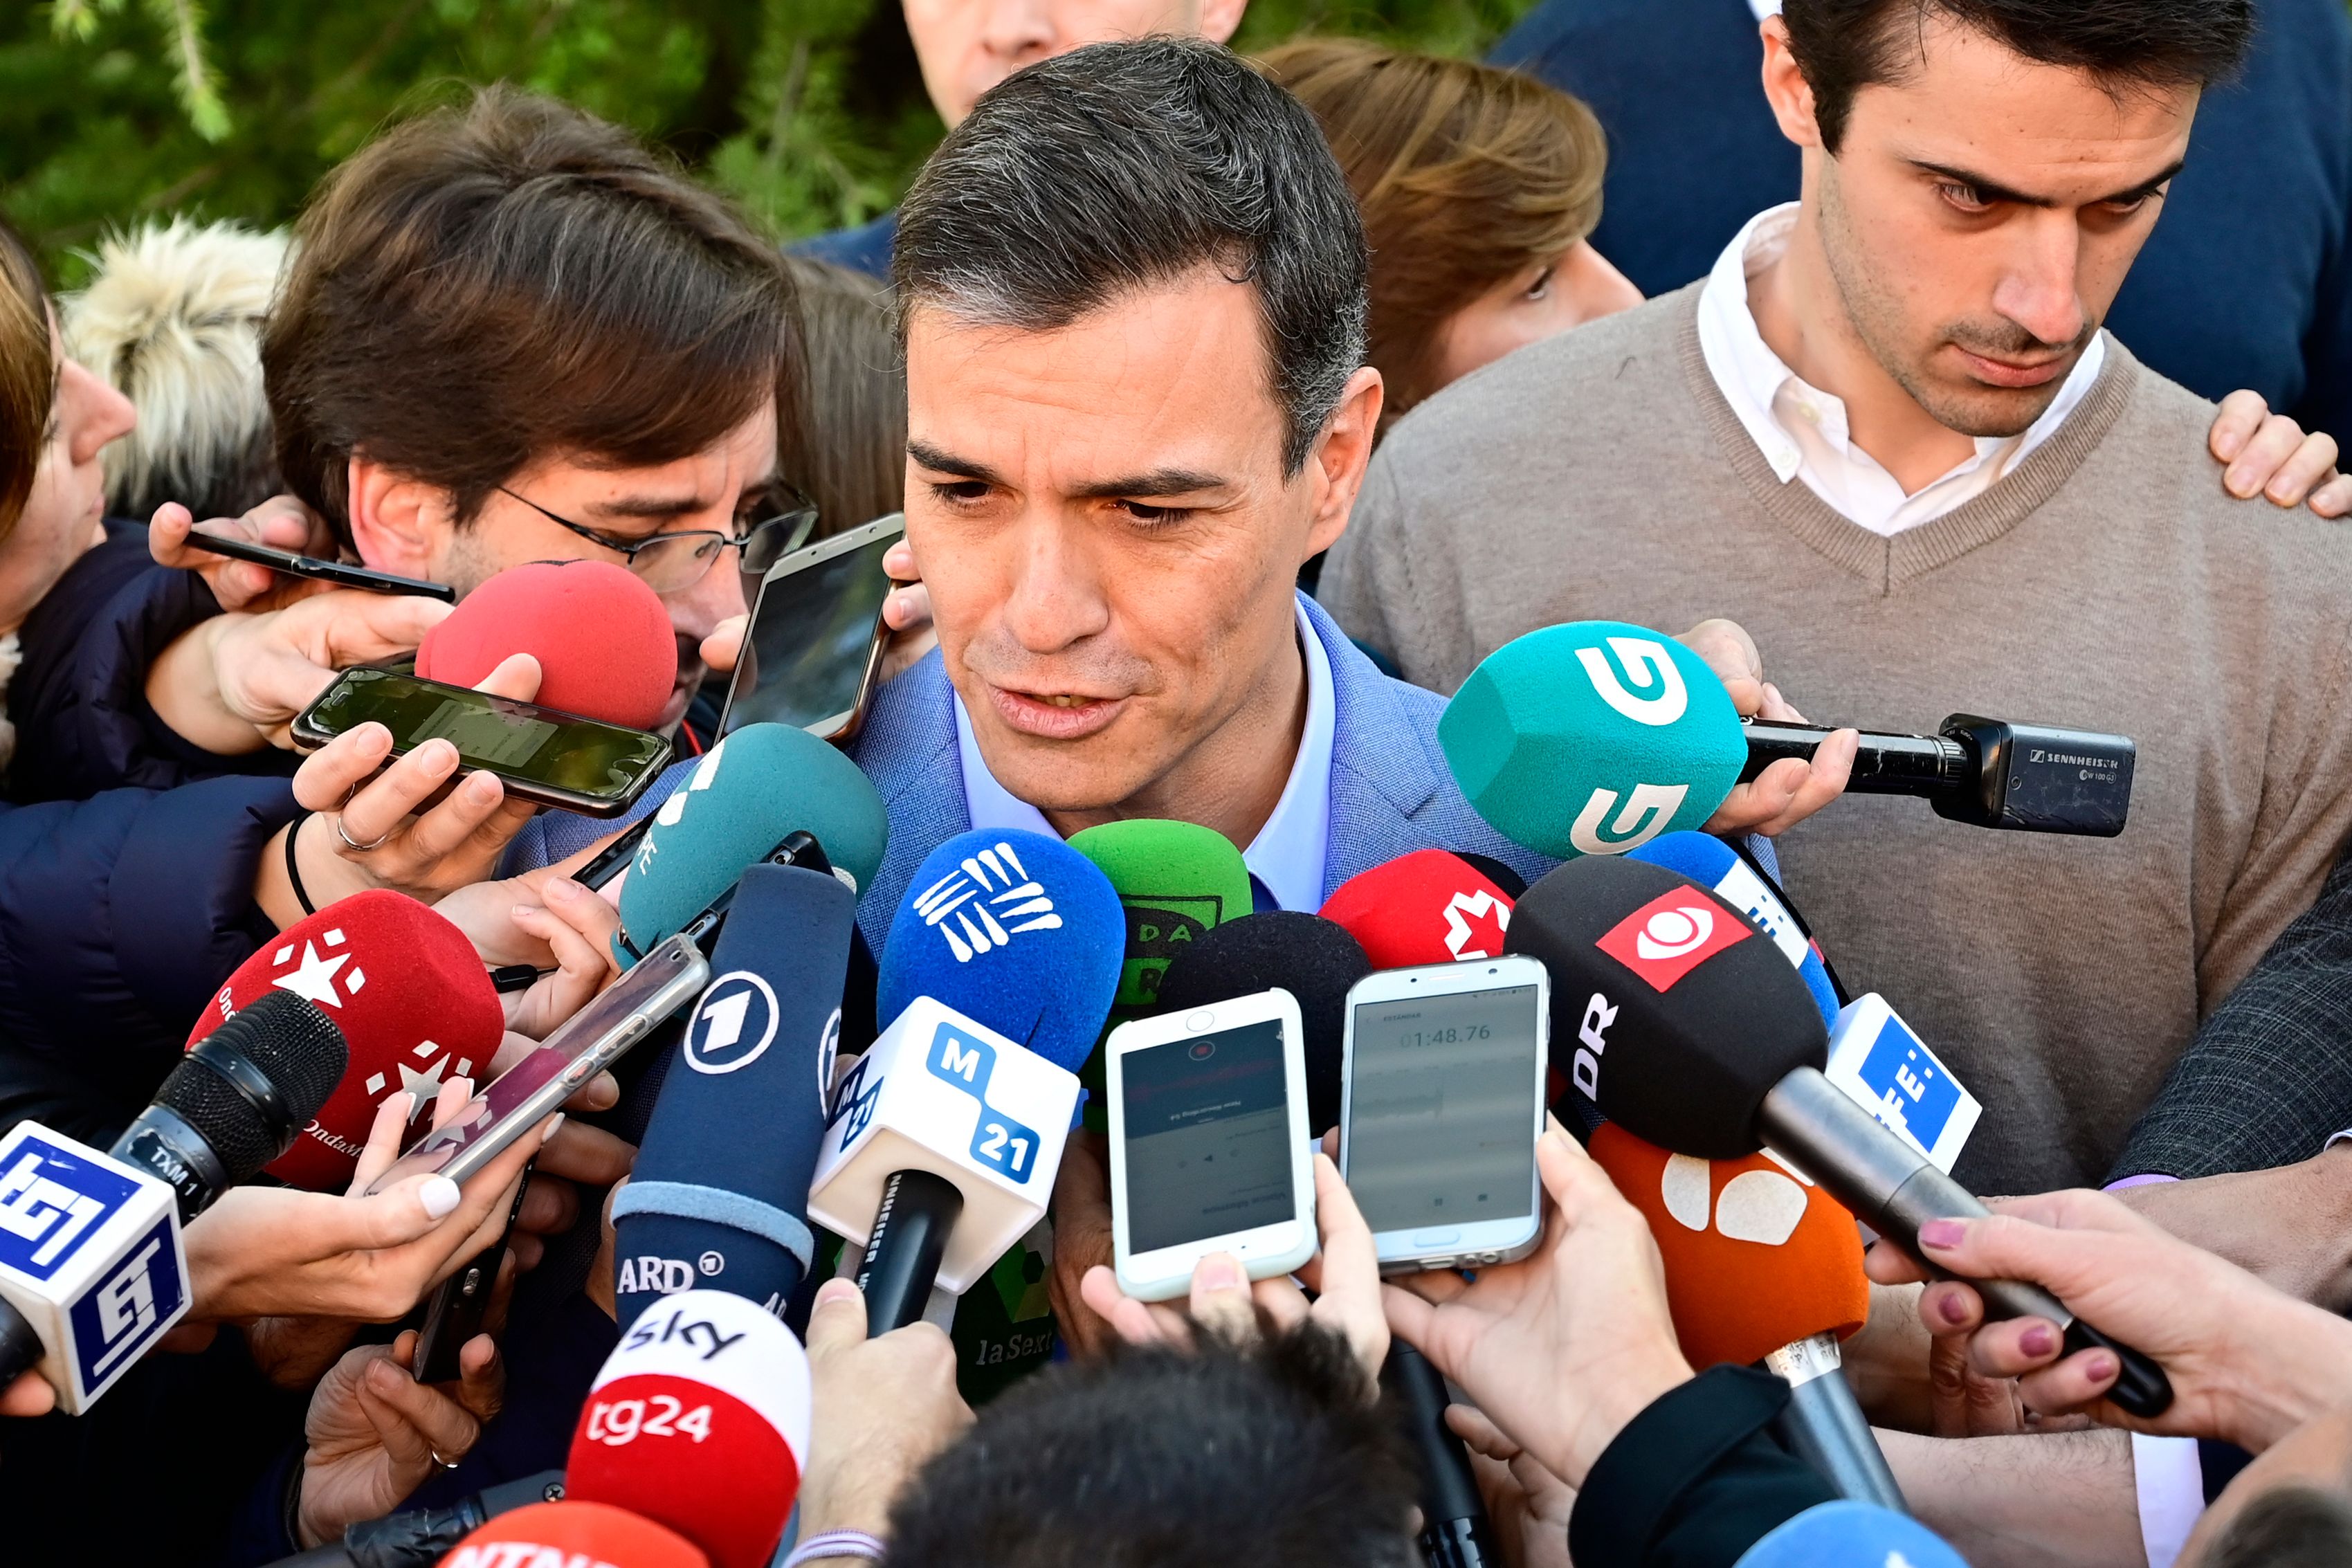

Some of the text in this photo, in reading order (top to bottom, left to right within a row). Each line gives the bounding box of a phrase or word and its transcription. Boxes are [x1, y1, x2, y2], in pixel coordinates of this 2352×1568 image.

[940, 1037, 981, 1083] M
[1573, 992, 1619, 1102] DR
[150, 1146, 198, 1196] TXM 1
[979, 1122, 1030, 1172] 21
[866, 1174, 902, 1264] NNHEISER
[617, 1255, 695, 1294] ARD
[625, 1310, 747, 1360] sky
[586, 1394, 713, 1446] tg24
